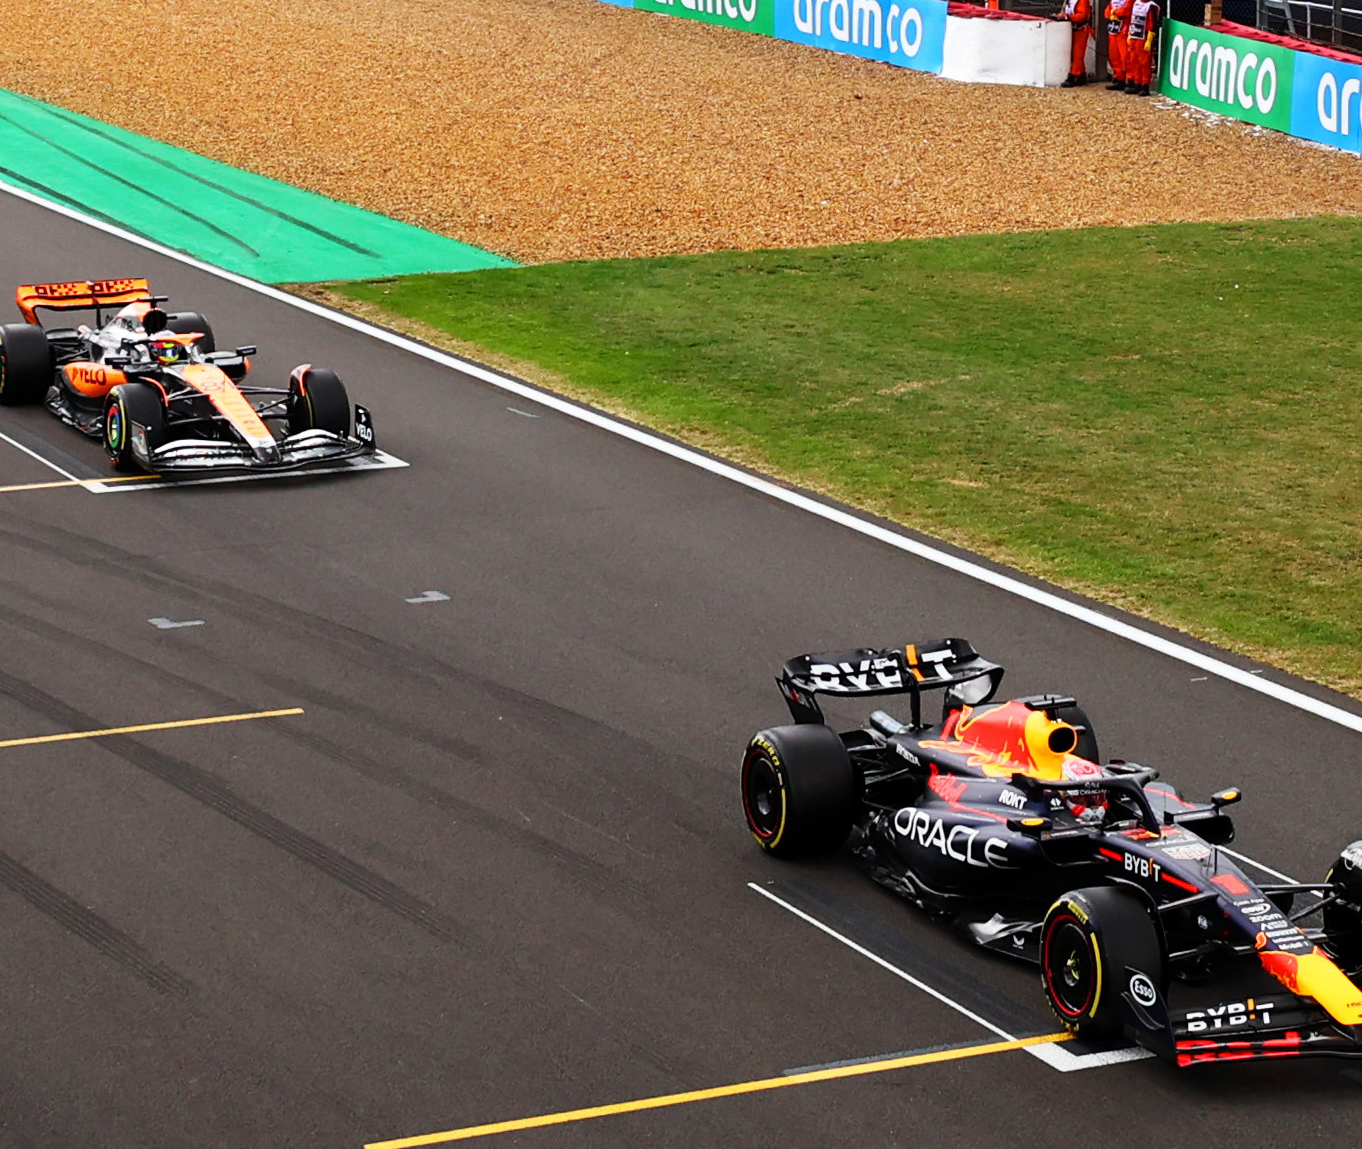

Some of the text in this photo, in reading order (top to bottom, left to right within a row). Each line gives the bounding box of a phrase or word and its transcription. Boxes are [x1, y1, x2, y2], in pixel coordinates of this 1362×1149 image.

[1170, 34, 1277, 113] aramco
[79, 367, 107, 386] VELO
[810, 644, 954, 692] BYBIT
[998, 789, 1028, 810] ROKT
[894, 807, 1017, 869] ORACLE
[1124, 852, 1162, 882] BYBIT
[1134, 980, 1153, 999] Esso
[1186, 998, 1274, 1032] BYBIT
